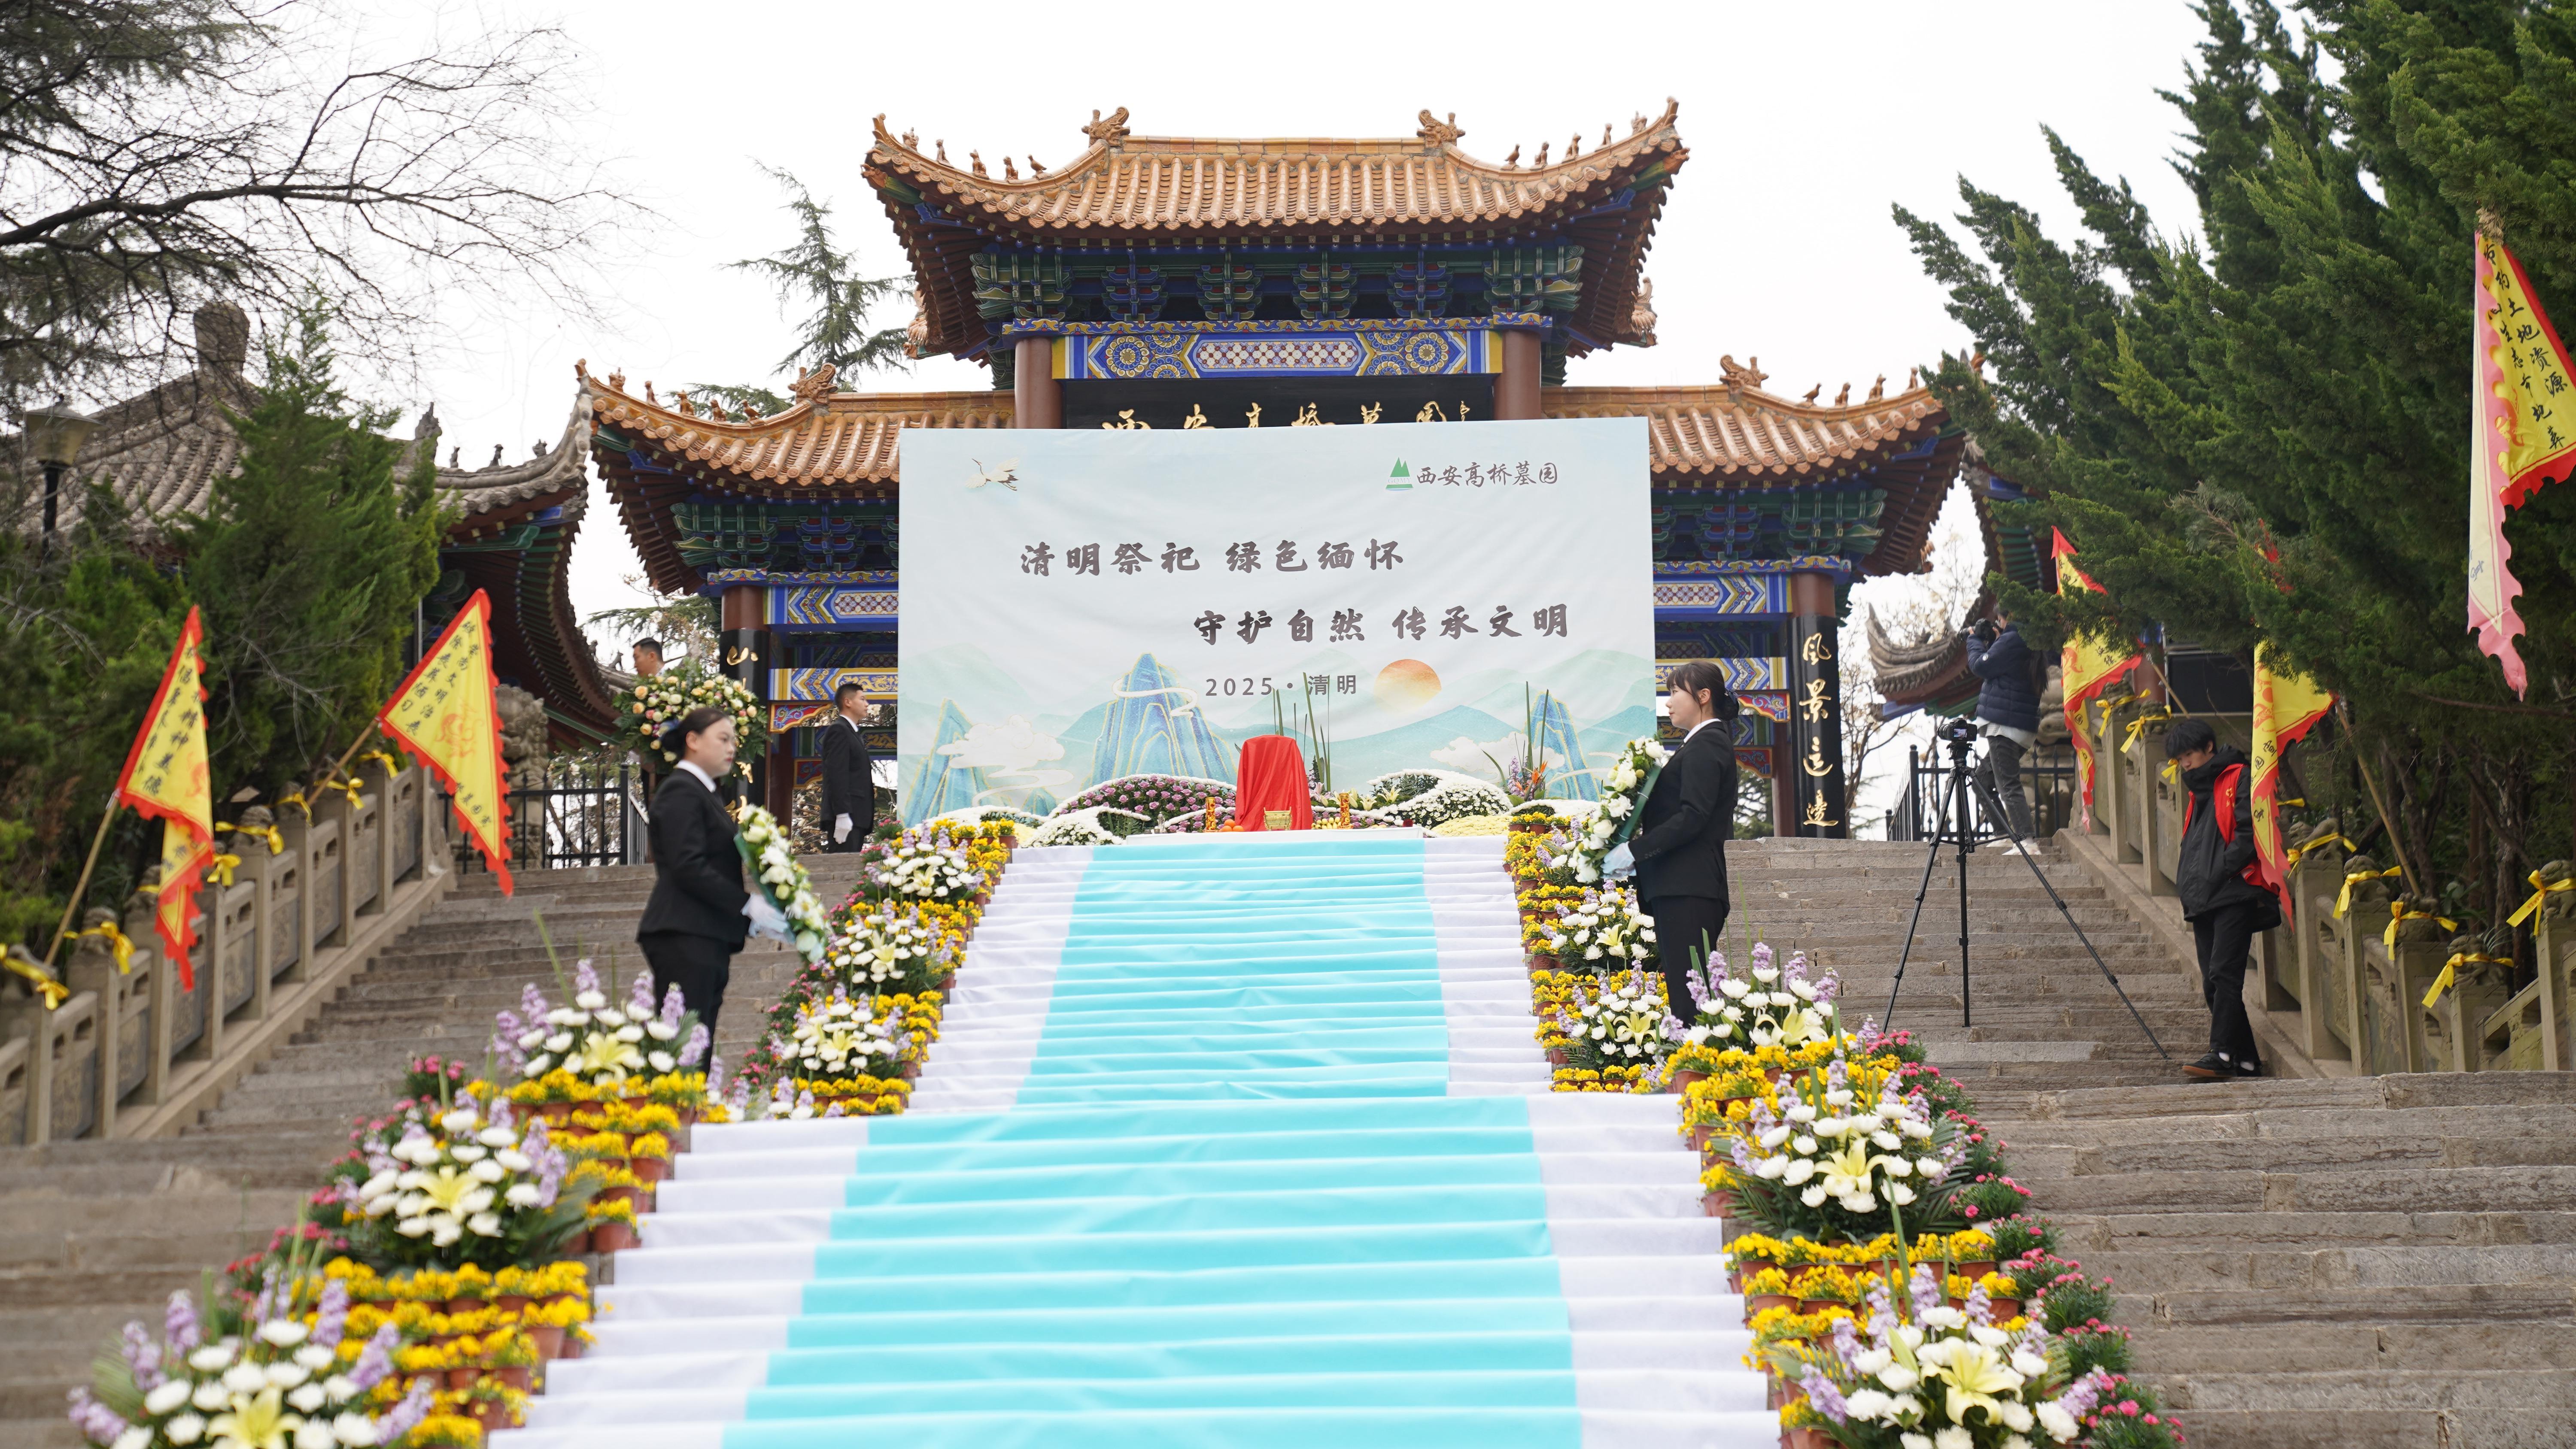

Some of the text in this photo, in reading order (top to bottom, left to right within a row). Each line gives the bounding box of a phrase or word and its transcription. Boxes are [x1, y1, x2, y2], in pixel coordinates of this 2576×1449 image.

[1417, 461, 1557, 487] 西安高桥墓园
[1021, 539, 1403, 576] 清明祭祀 绿色缅怀
[1194, 603, 1567, 645] 守护自然 传承文明
[401, 621, 476, 712] 破除丧葬陋习
